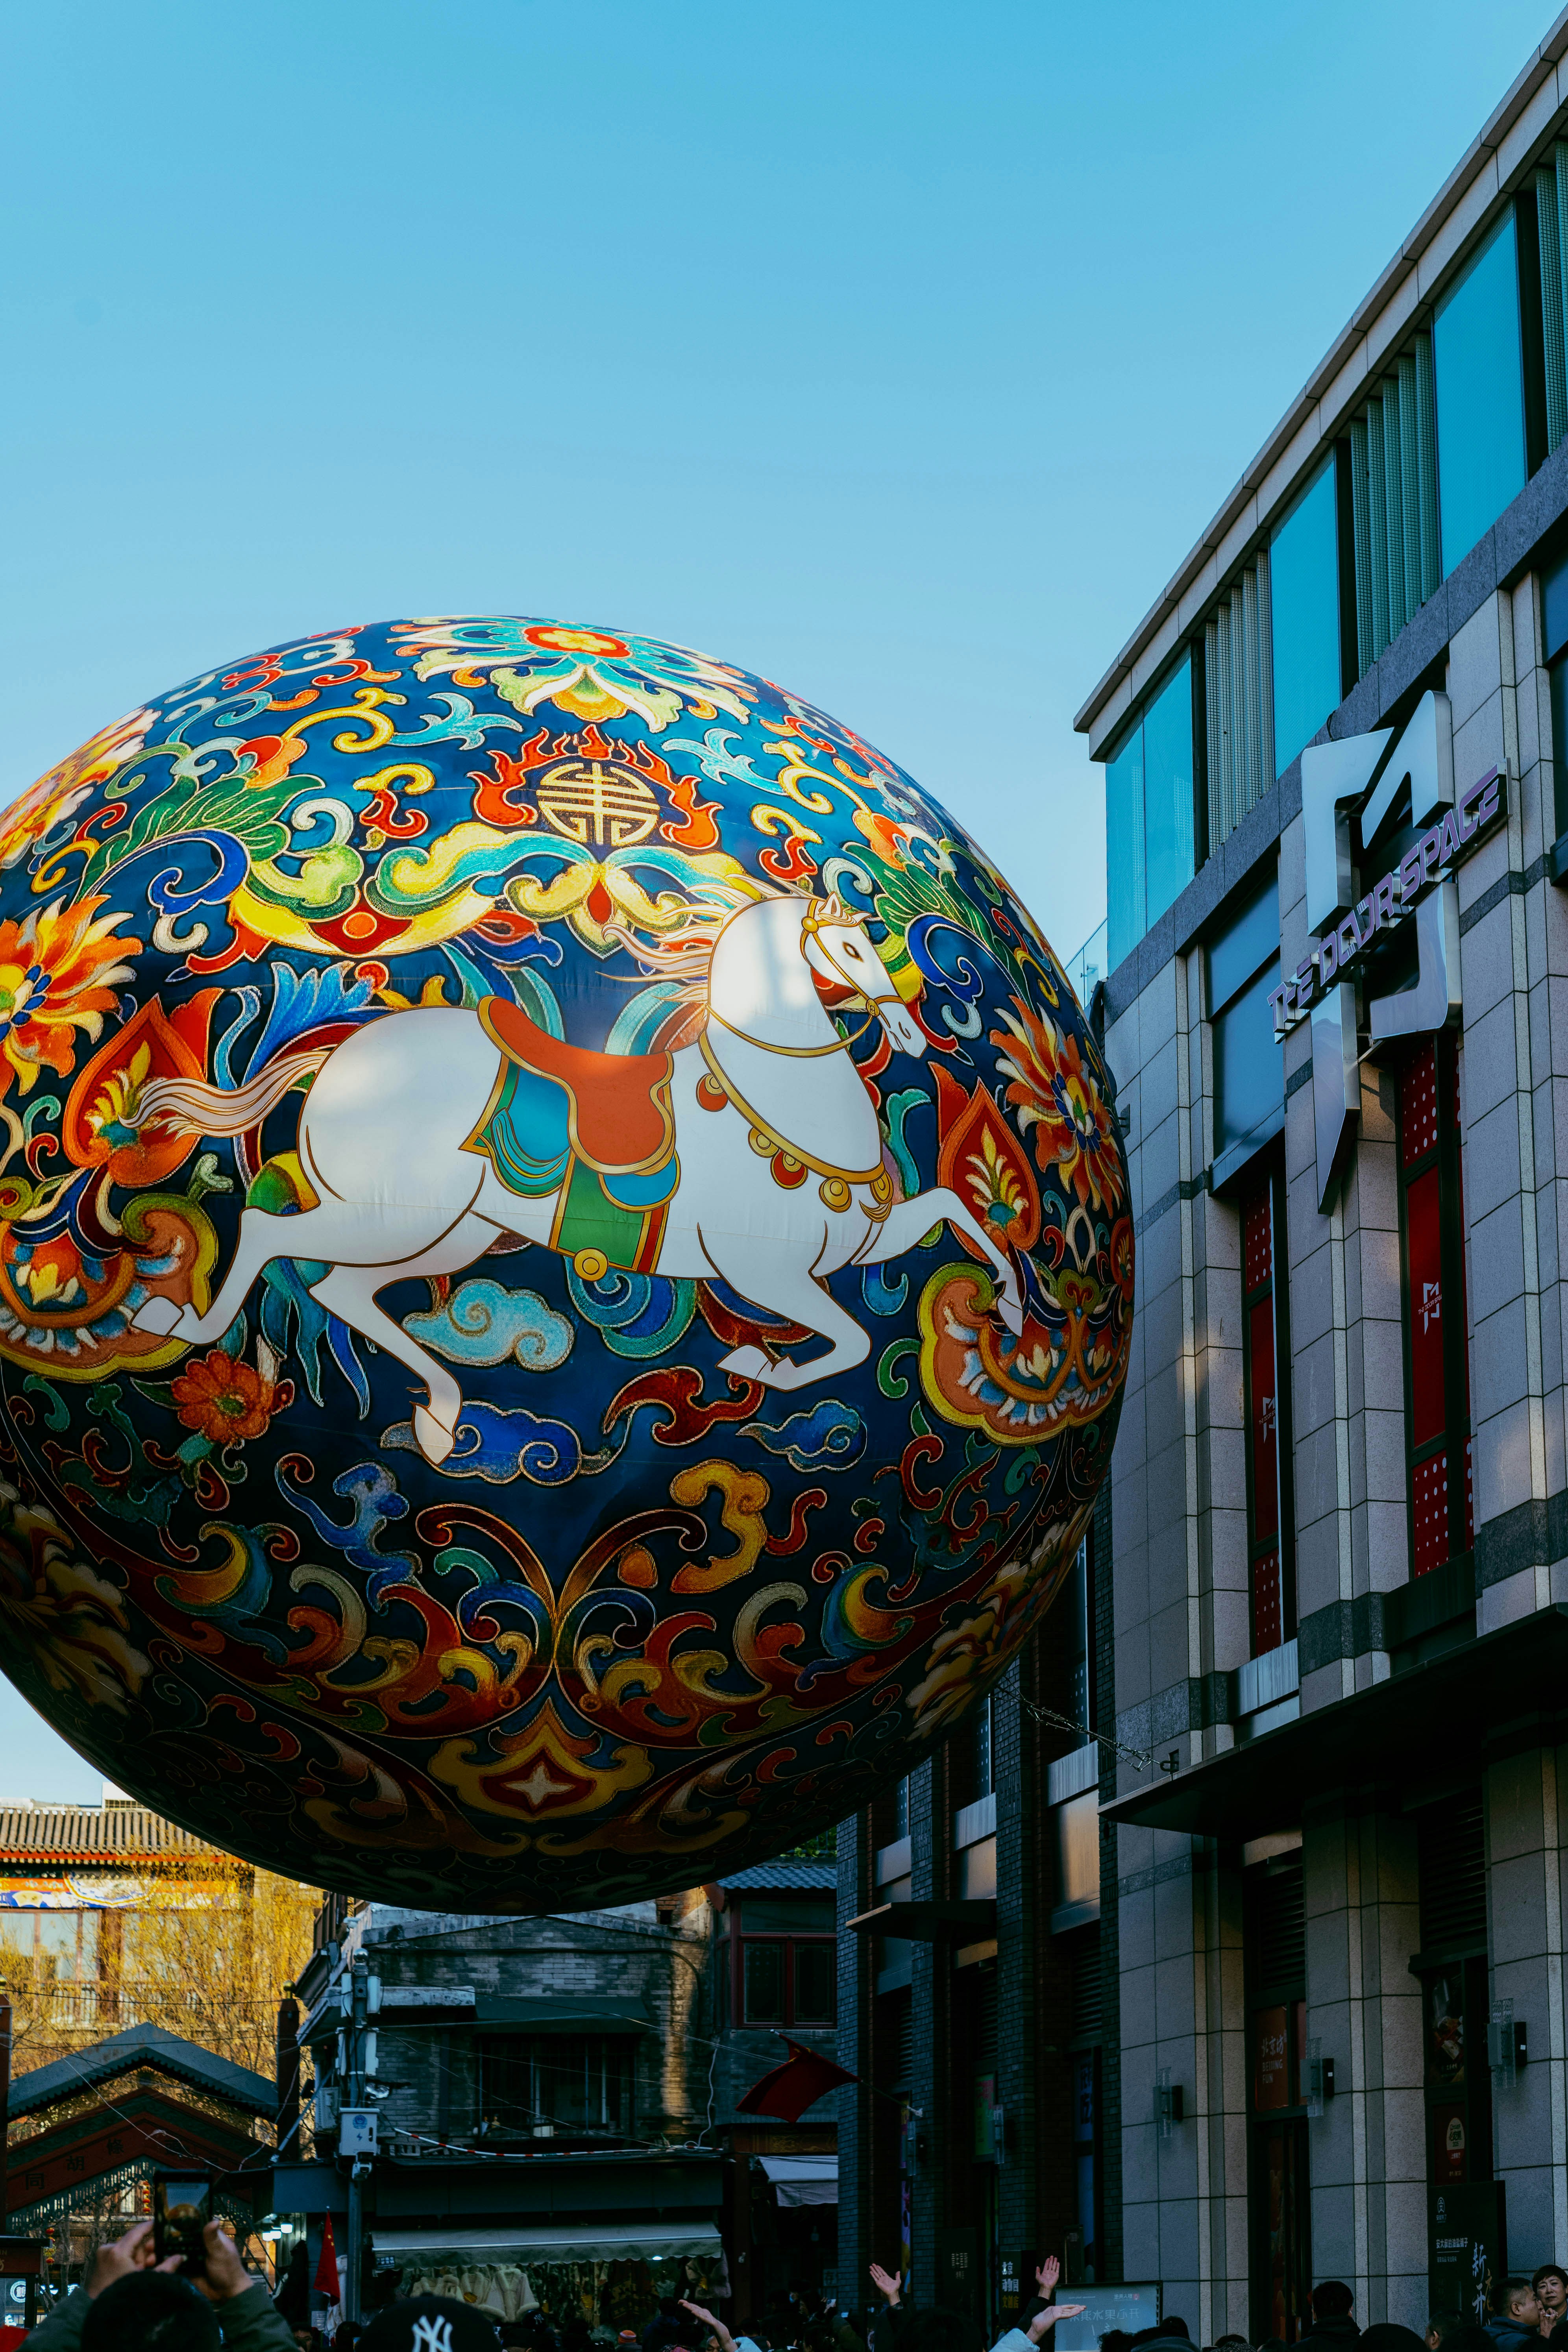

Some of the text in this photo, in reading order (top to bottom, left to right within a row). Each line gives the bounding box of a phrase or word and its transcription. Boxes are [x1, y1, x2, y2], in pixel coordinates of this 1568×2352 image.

[1267, 764, 1500, 1030] THE DOOR SPACE
[1425, 1300, 1434, 1310] DOOR
[1262, 2034, 1284, 2058] 北京坊
[1263, 2059, 1283, 2072] BEIJING
[1263, 2073, 1274, 2084] FUN
[1436, 2237, 1468, 2248] 安大叔的油盐铺子
[411, 2315, 453, 2352] NY
